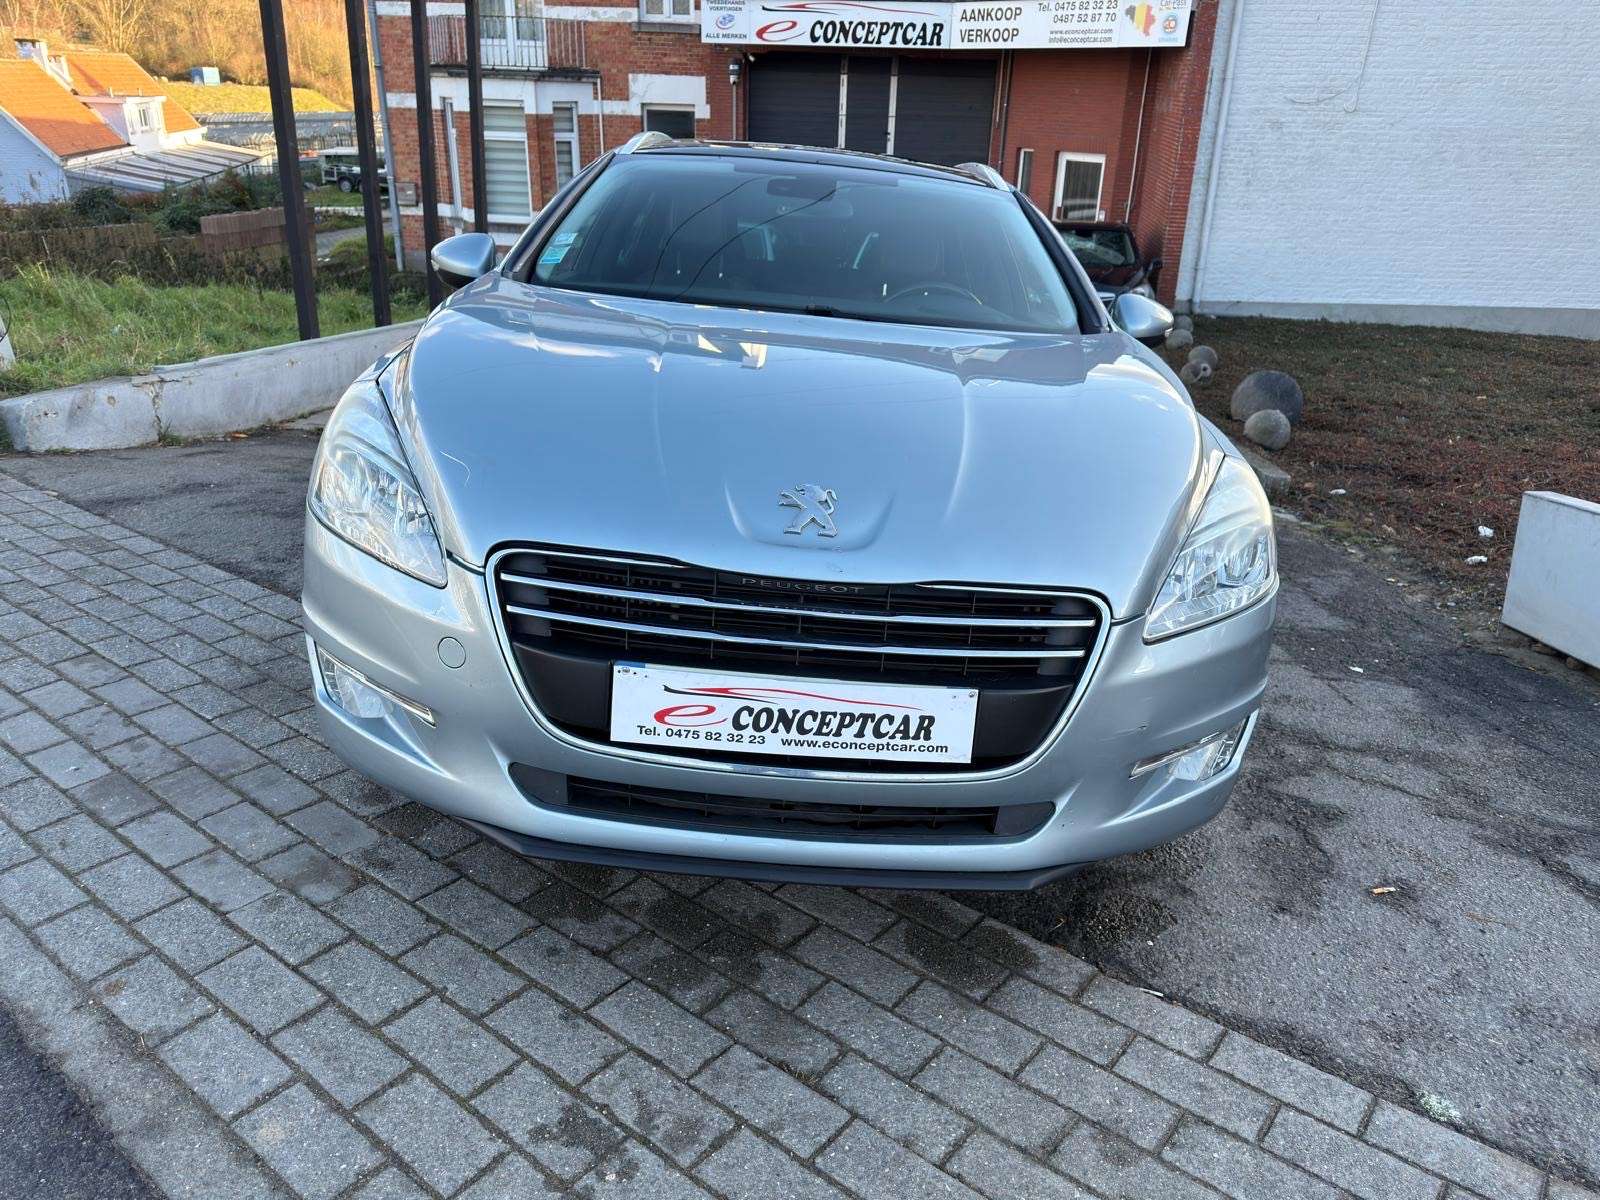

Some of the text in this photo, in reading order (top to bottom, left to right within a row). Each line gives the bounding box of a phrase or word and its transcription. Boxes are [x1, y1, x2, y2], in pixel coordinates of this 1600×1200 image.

[1038, 0, 1118, 11] Tel. 0475 82 32 23
[960, 7, 1022, 21] AANKOOP
[1053, 12, 1117, 23] 0487 52 87 70
[810, 20, 944, 46] CONCEPTCAR
[960, 28, 1019, 42] VERKOOP
[1049, 36, 1112, 44] info@econceptcar.com
[742, 578, 864, 593] PEUGEOT
[731, 705, 936, 742] CONCEPTCAR
[637, 725, 766, 745] Tel. 0475 82 32 23
[781, 738, 949, 753] www.econceptcar.com
